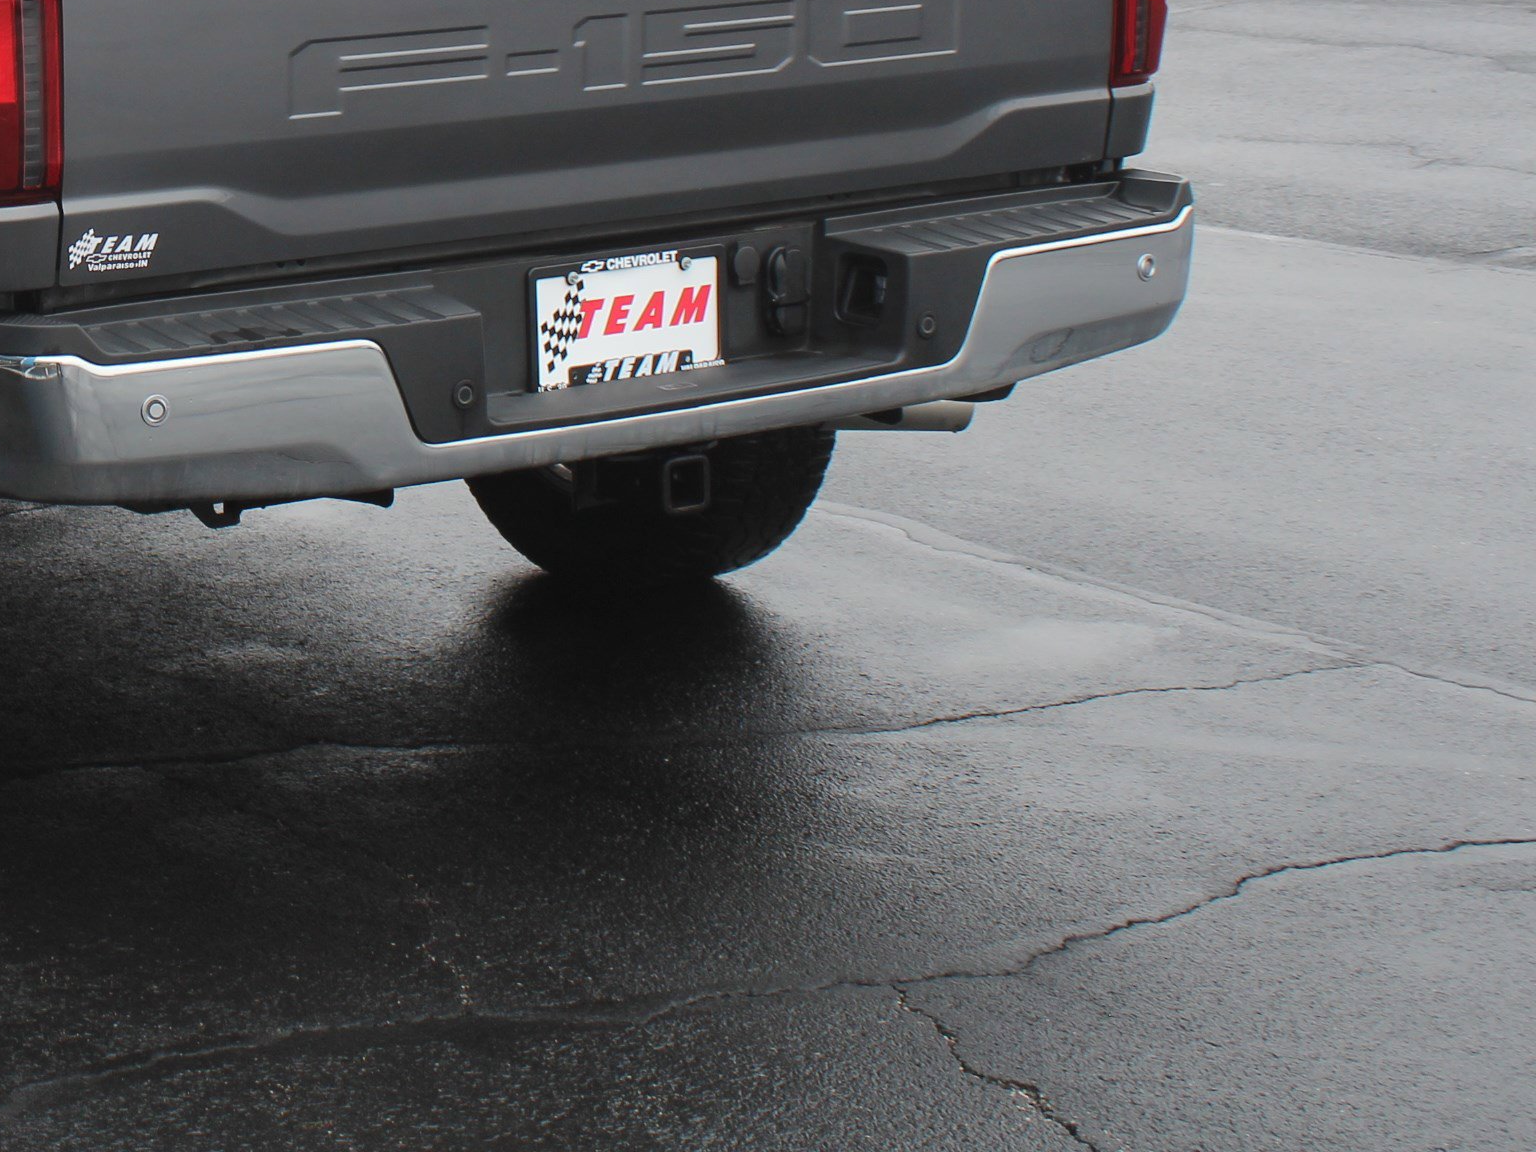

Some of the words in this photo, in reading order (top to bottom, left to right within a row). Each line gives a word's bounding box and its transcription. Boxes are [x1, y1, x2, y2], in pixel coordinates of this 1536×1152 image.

[89, 232, 159, 255] TEAM
[107, 251, 152, 262] CHEVROLET
[606, 250, 678, 271] CHEVROLET
[577, 284, 712, 340] TEAM
[602, 350, 680, 382] TEAM
